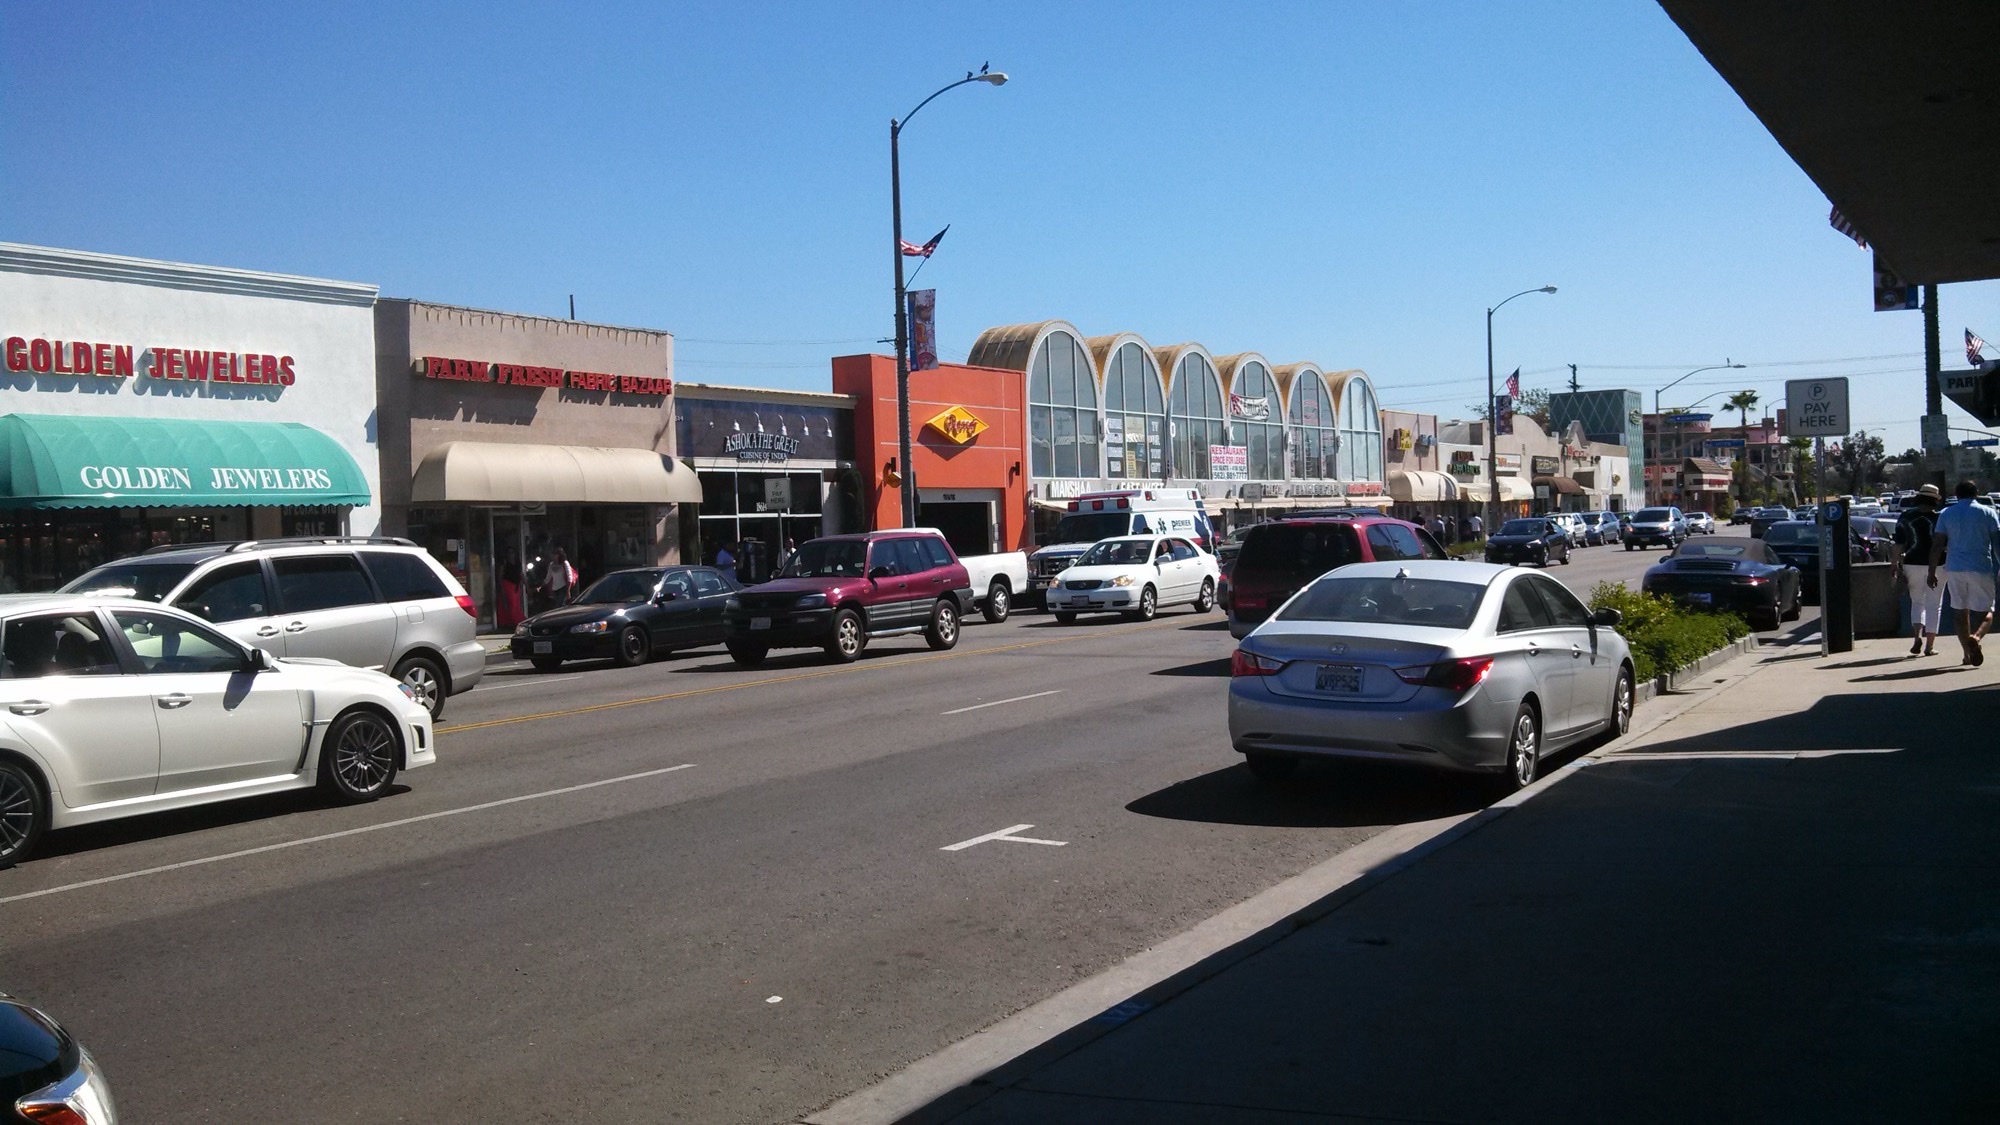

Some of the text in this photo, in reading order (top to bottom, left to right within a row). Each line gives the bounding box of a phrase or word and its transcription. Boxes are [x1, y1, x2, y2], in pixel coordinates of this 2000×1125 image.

[6, 336, 296, 386] GOLDEN JEWELERS
[426, 356, 672, 395] FARM FRESH FABRIC BAZAAR
[1813, 386, 1822, 396] P
[1803, 401, 1831, 415] PAY
[1799, 414, 1837, 428] HERE
[725, 432, 800, 455] ASHOKA THE GREAT
[739, 451, 762, 459] CUISINE
[771, 452, 788, 460] INDIA
[1211, 447, 1246, 455] RESTAURANT
[1212, 456, 1225, 464] SPACE
[1234, 456, 1246, 464] LEASE
[80, 466, 332, 490] GOLDEN JEWELERS
[1829, 505, 1838, 518] P
[295, 521, 326, 536] SALE
